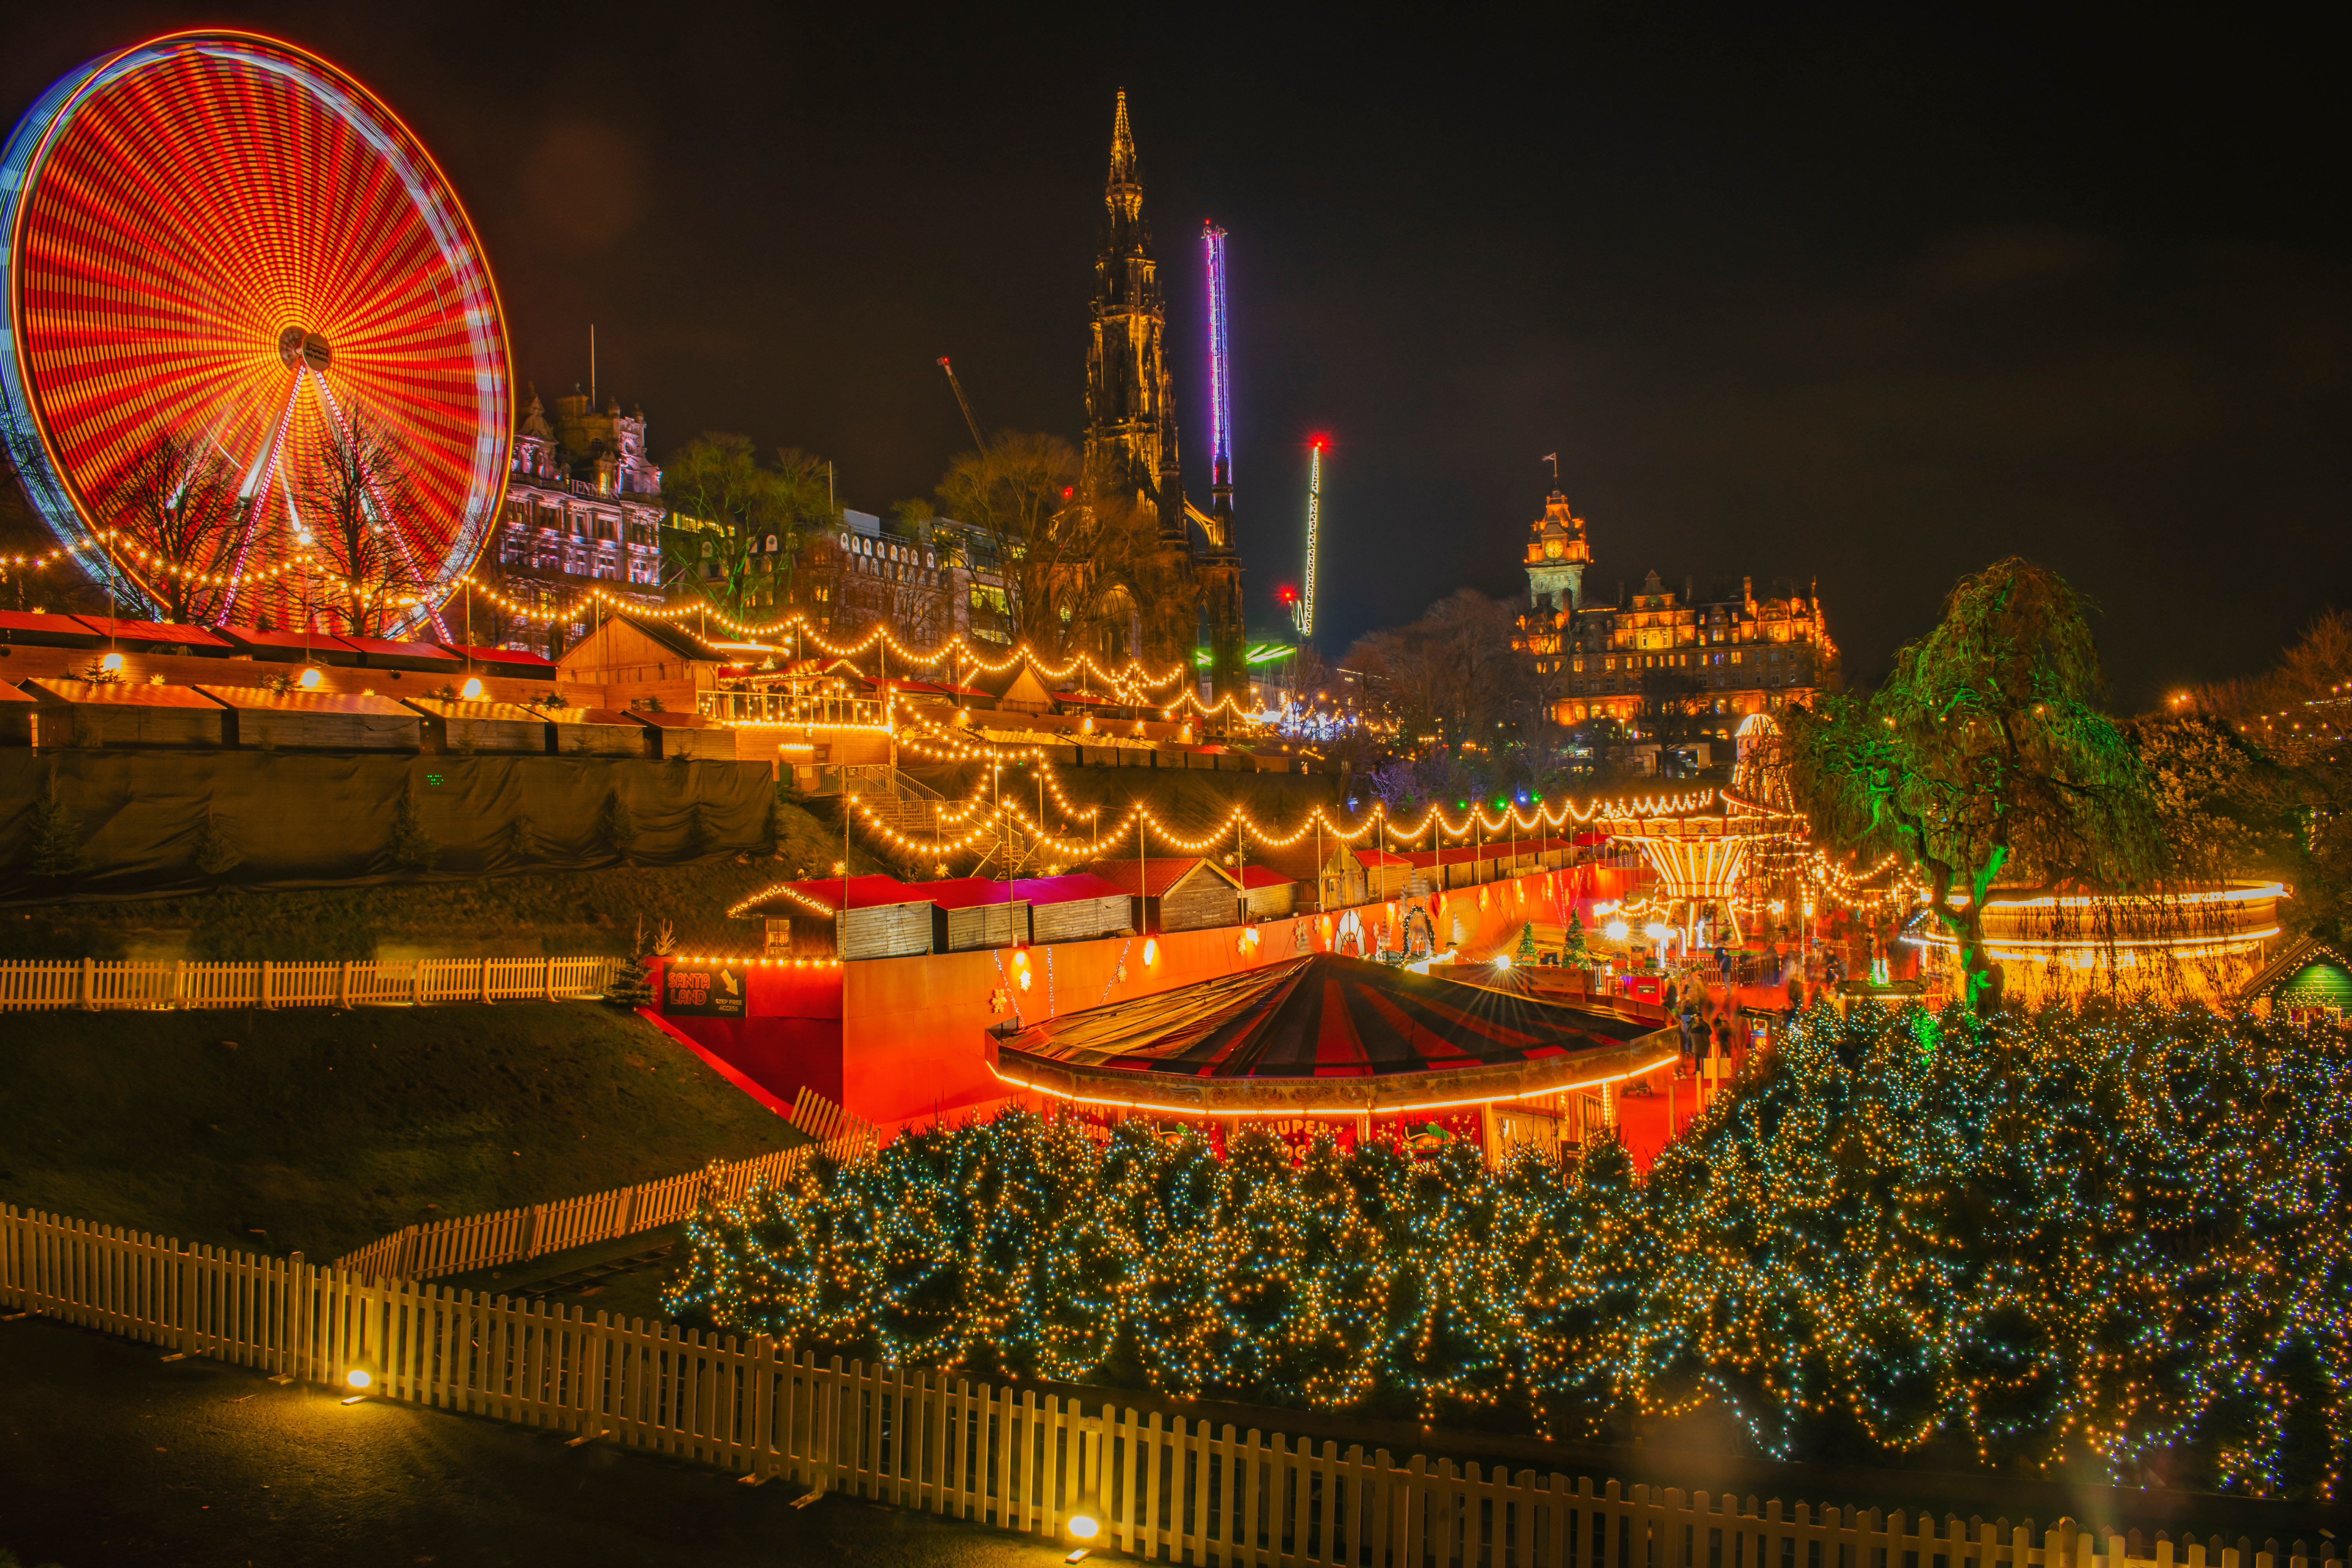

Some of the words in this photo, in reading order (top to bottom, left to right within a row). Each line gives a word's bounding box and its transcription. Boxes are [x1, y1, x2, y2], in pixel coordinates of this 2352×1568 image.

[314, 355, 329, 363] WHEEL
[668, 973, 710, 989] SANTA
[670, 989, 707, 1005] LAND
[1073, 1101, 1104, 1120] SUPER
